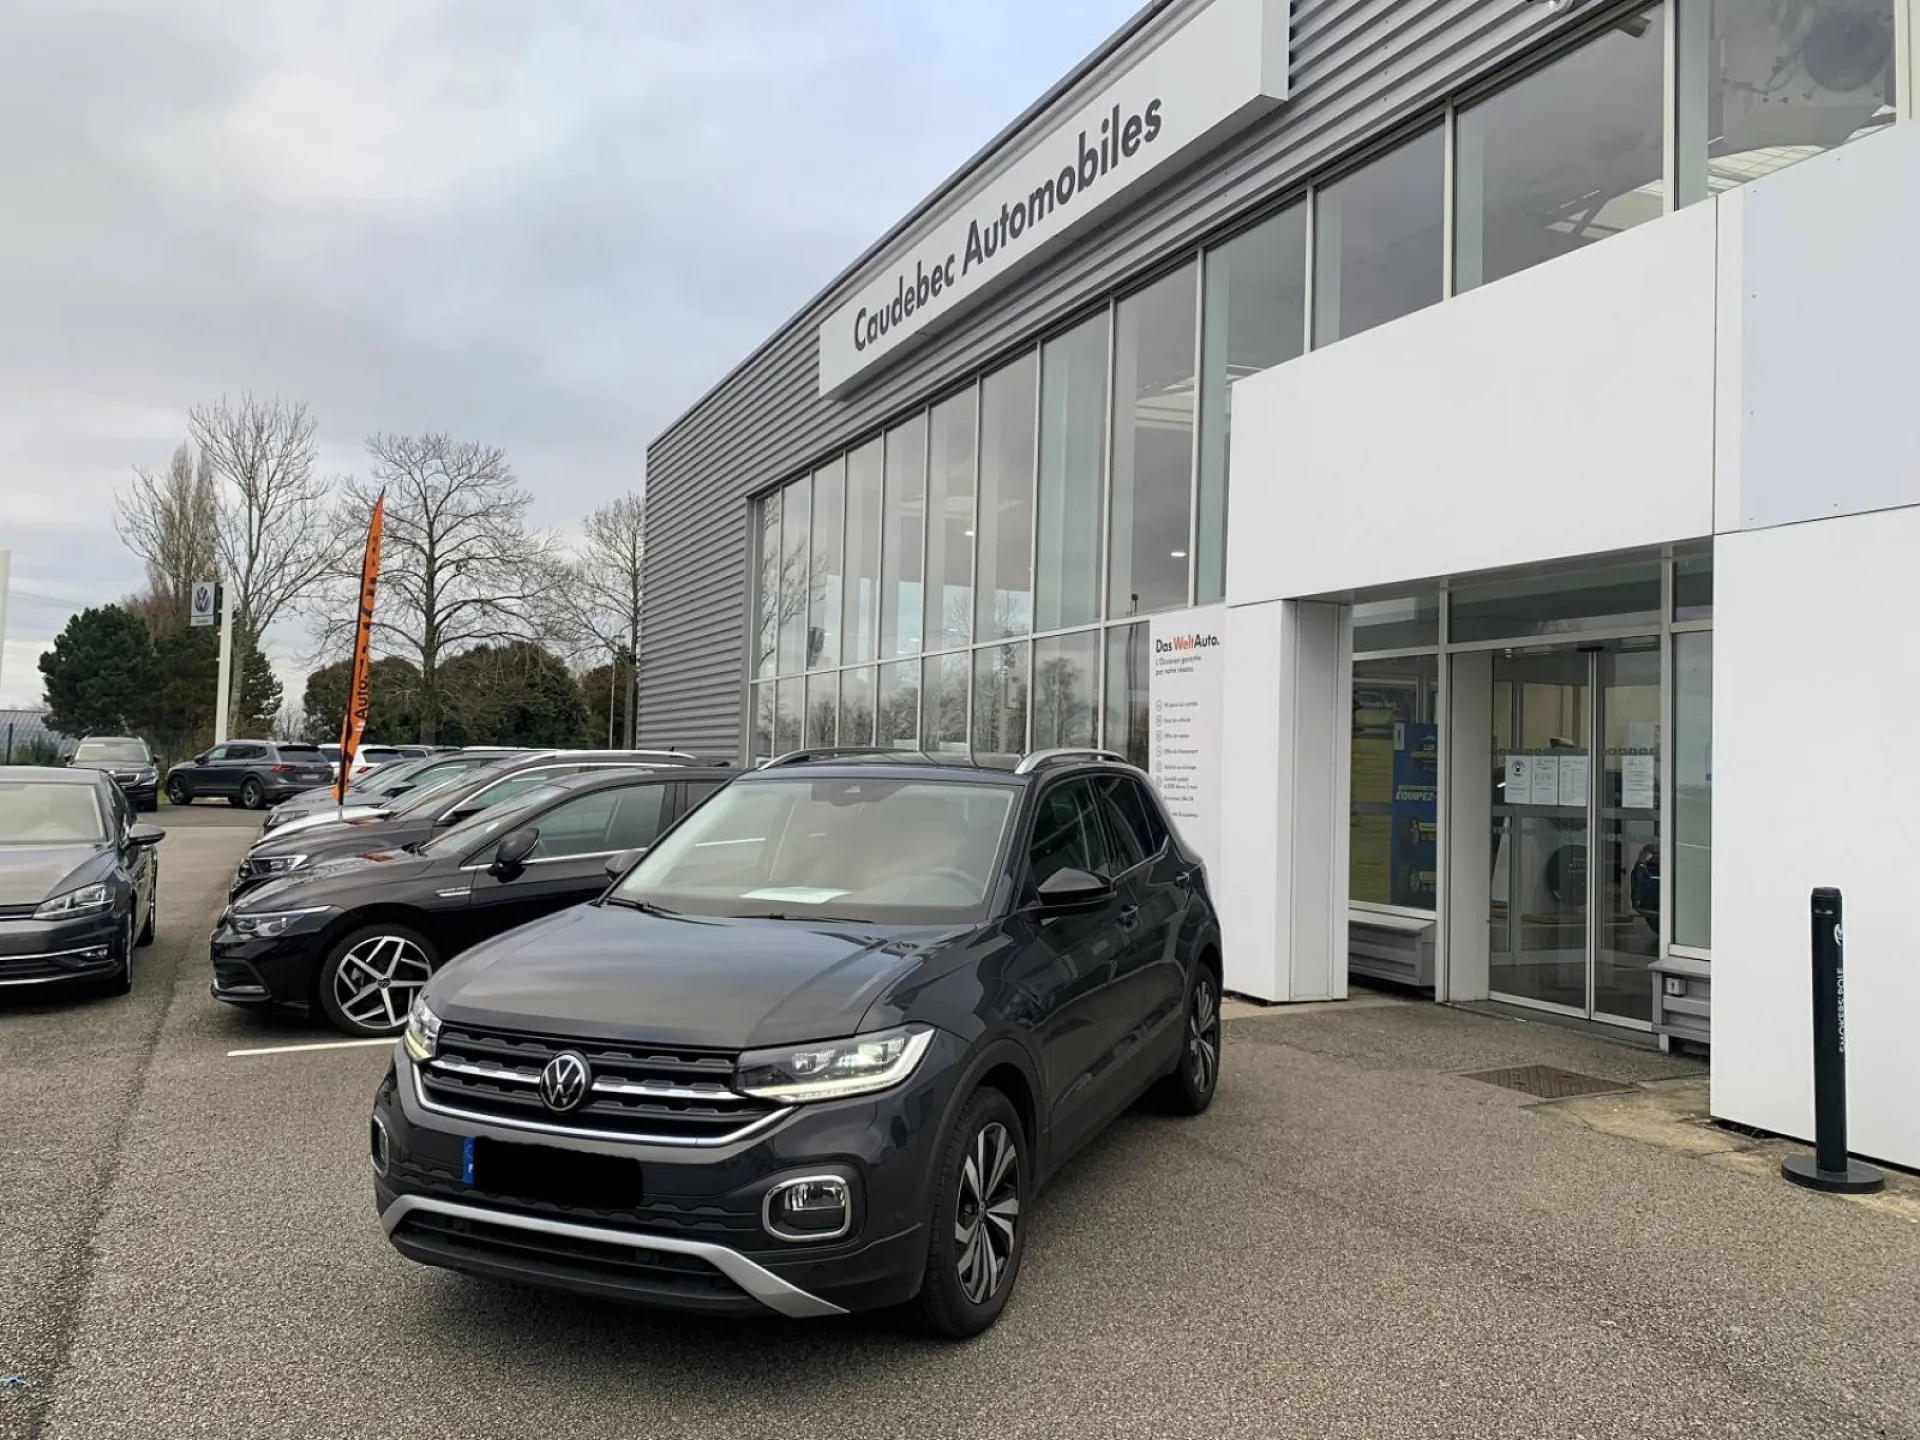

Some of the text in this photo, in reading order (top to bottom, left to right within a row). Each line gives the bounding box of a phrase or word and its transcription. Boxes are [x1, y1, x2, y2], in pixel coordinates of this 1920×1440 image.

[854, 98, 1162, 351] Caudebec Automobiles
[1155, 633, 1220, 653] Das WeltAuto.
